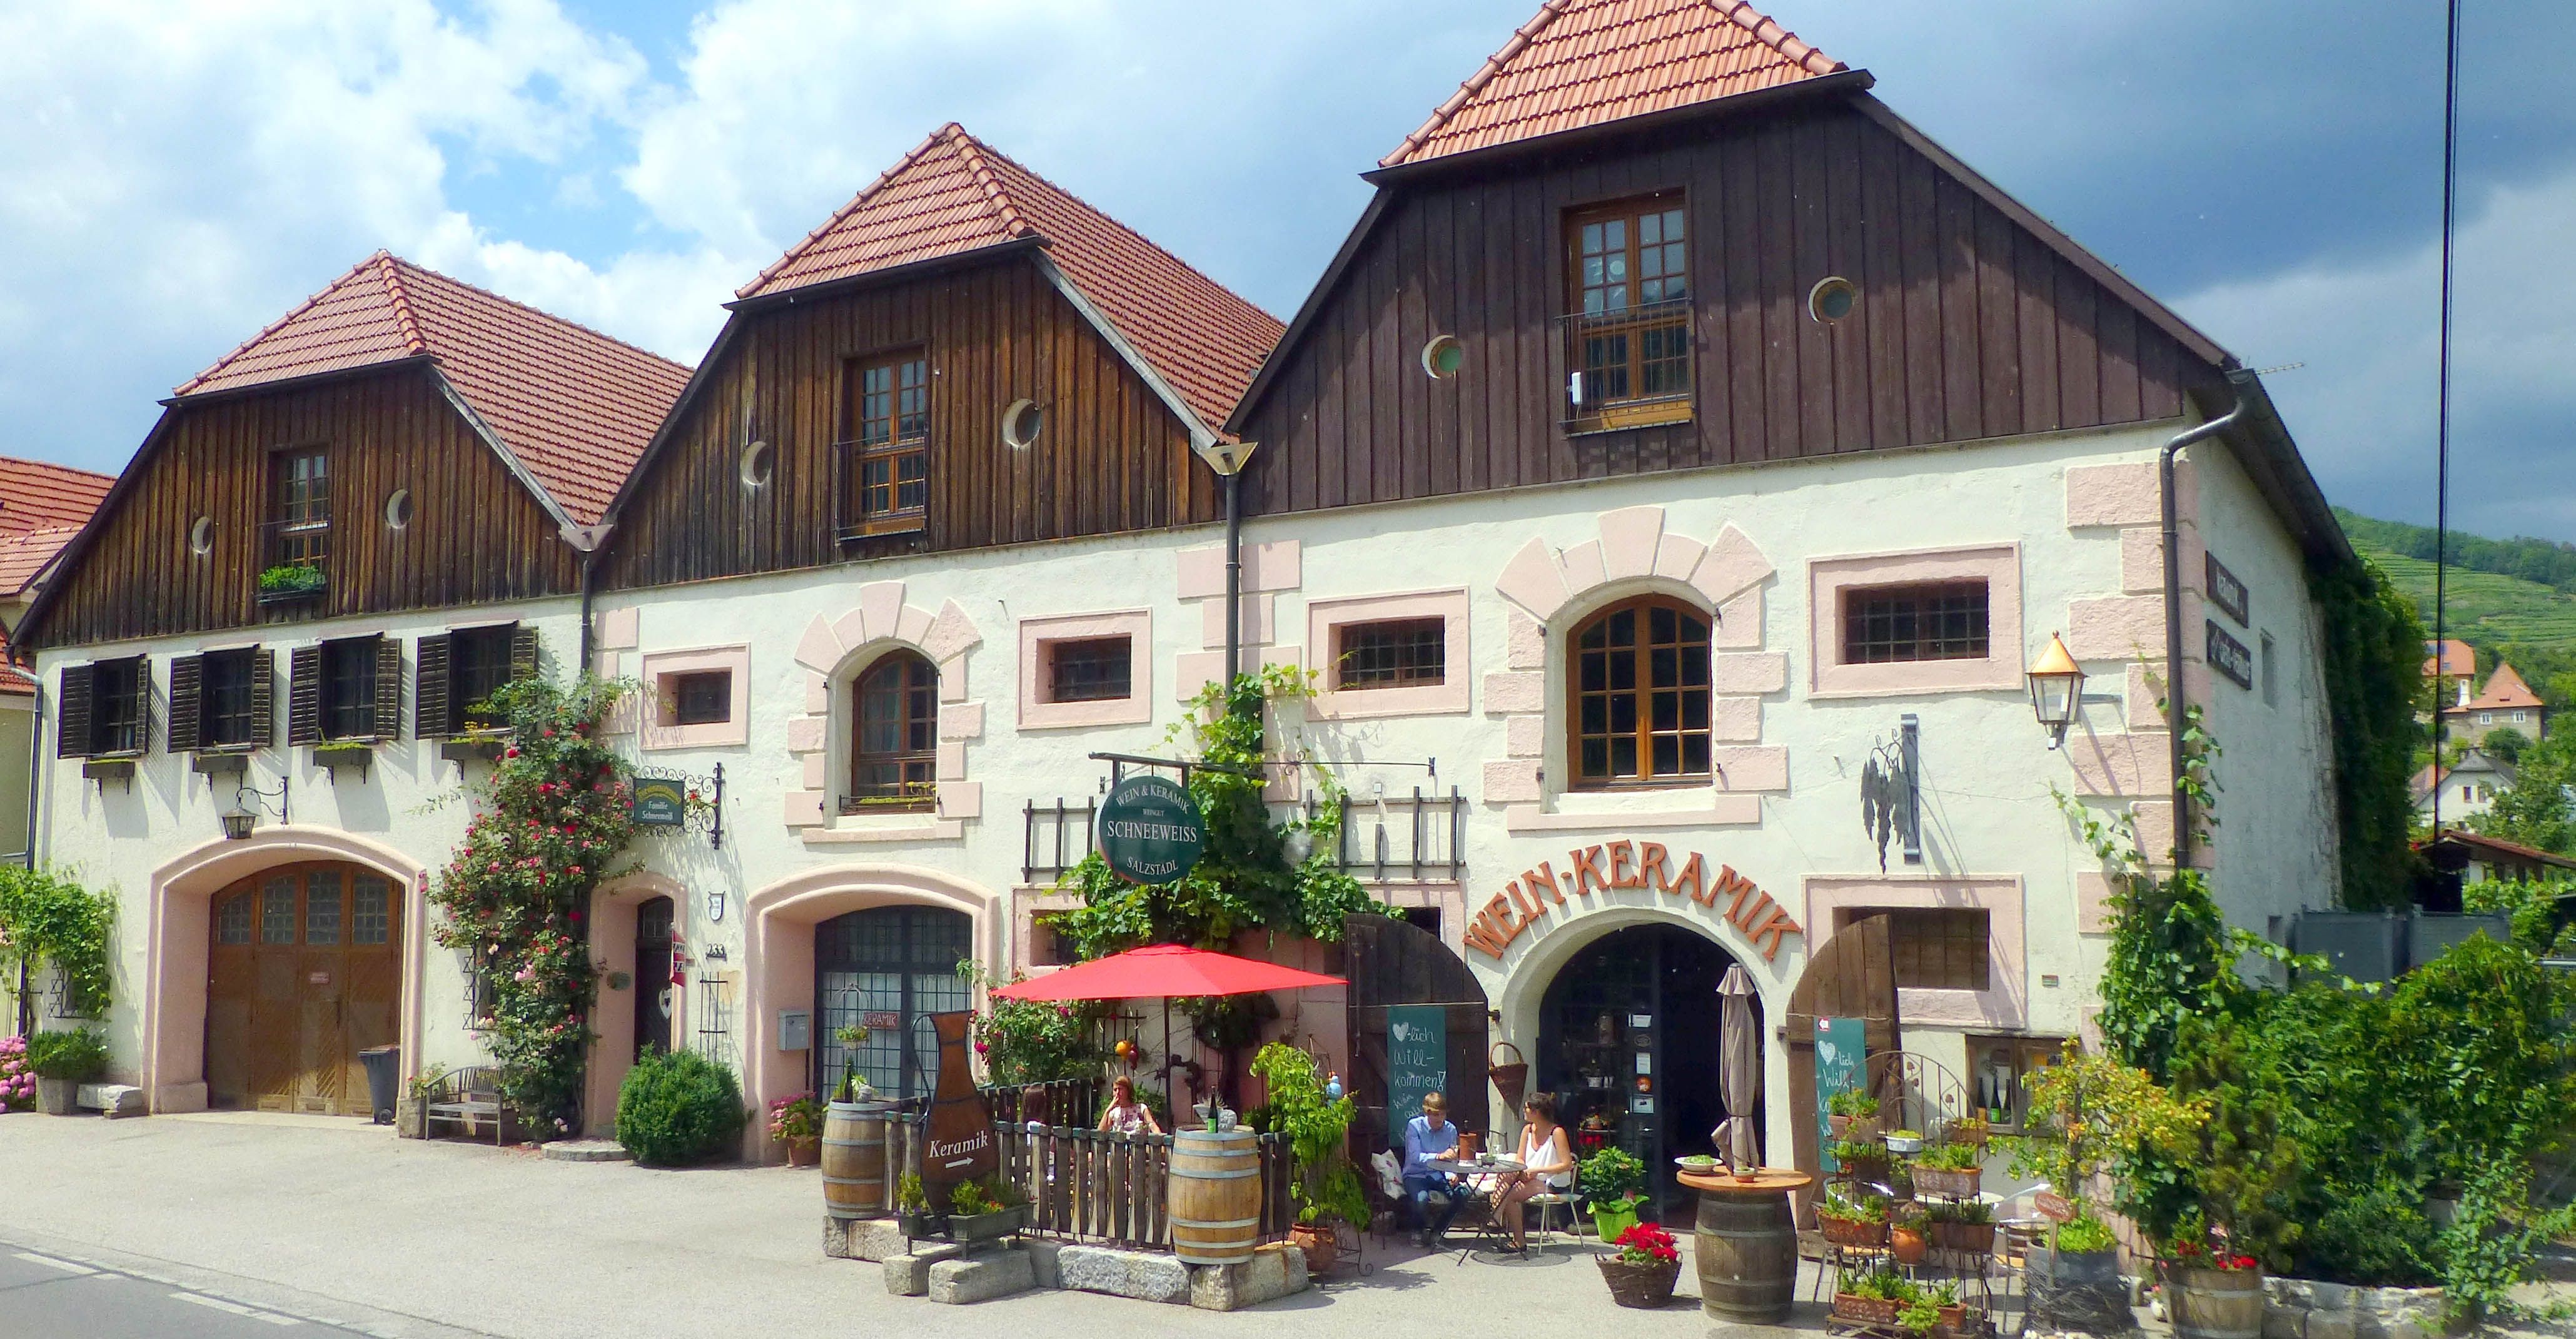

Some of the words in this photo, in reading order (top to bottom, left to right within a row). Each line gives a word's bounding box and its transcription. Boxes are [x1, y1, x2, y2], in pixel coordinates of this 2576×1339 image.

[648, 801, 669, 810] Familie
[1116, 785, 1140, 807] WEIN
[1141, 785, 1149, 796] &
[1150, 784, 1190, 815] KERAMIK
[1142, 808, 1165, 817] WEINGUT
[1107, 821, 1197, 843] SCHNEEWEISS
[1126, 856, 1179, 876] SALZSTADL
[707, 943, 725, 956] 233
[864, 1013, 897, 1027] KERAMIK
[929, 1129, 989, 1158] Keramik
